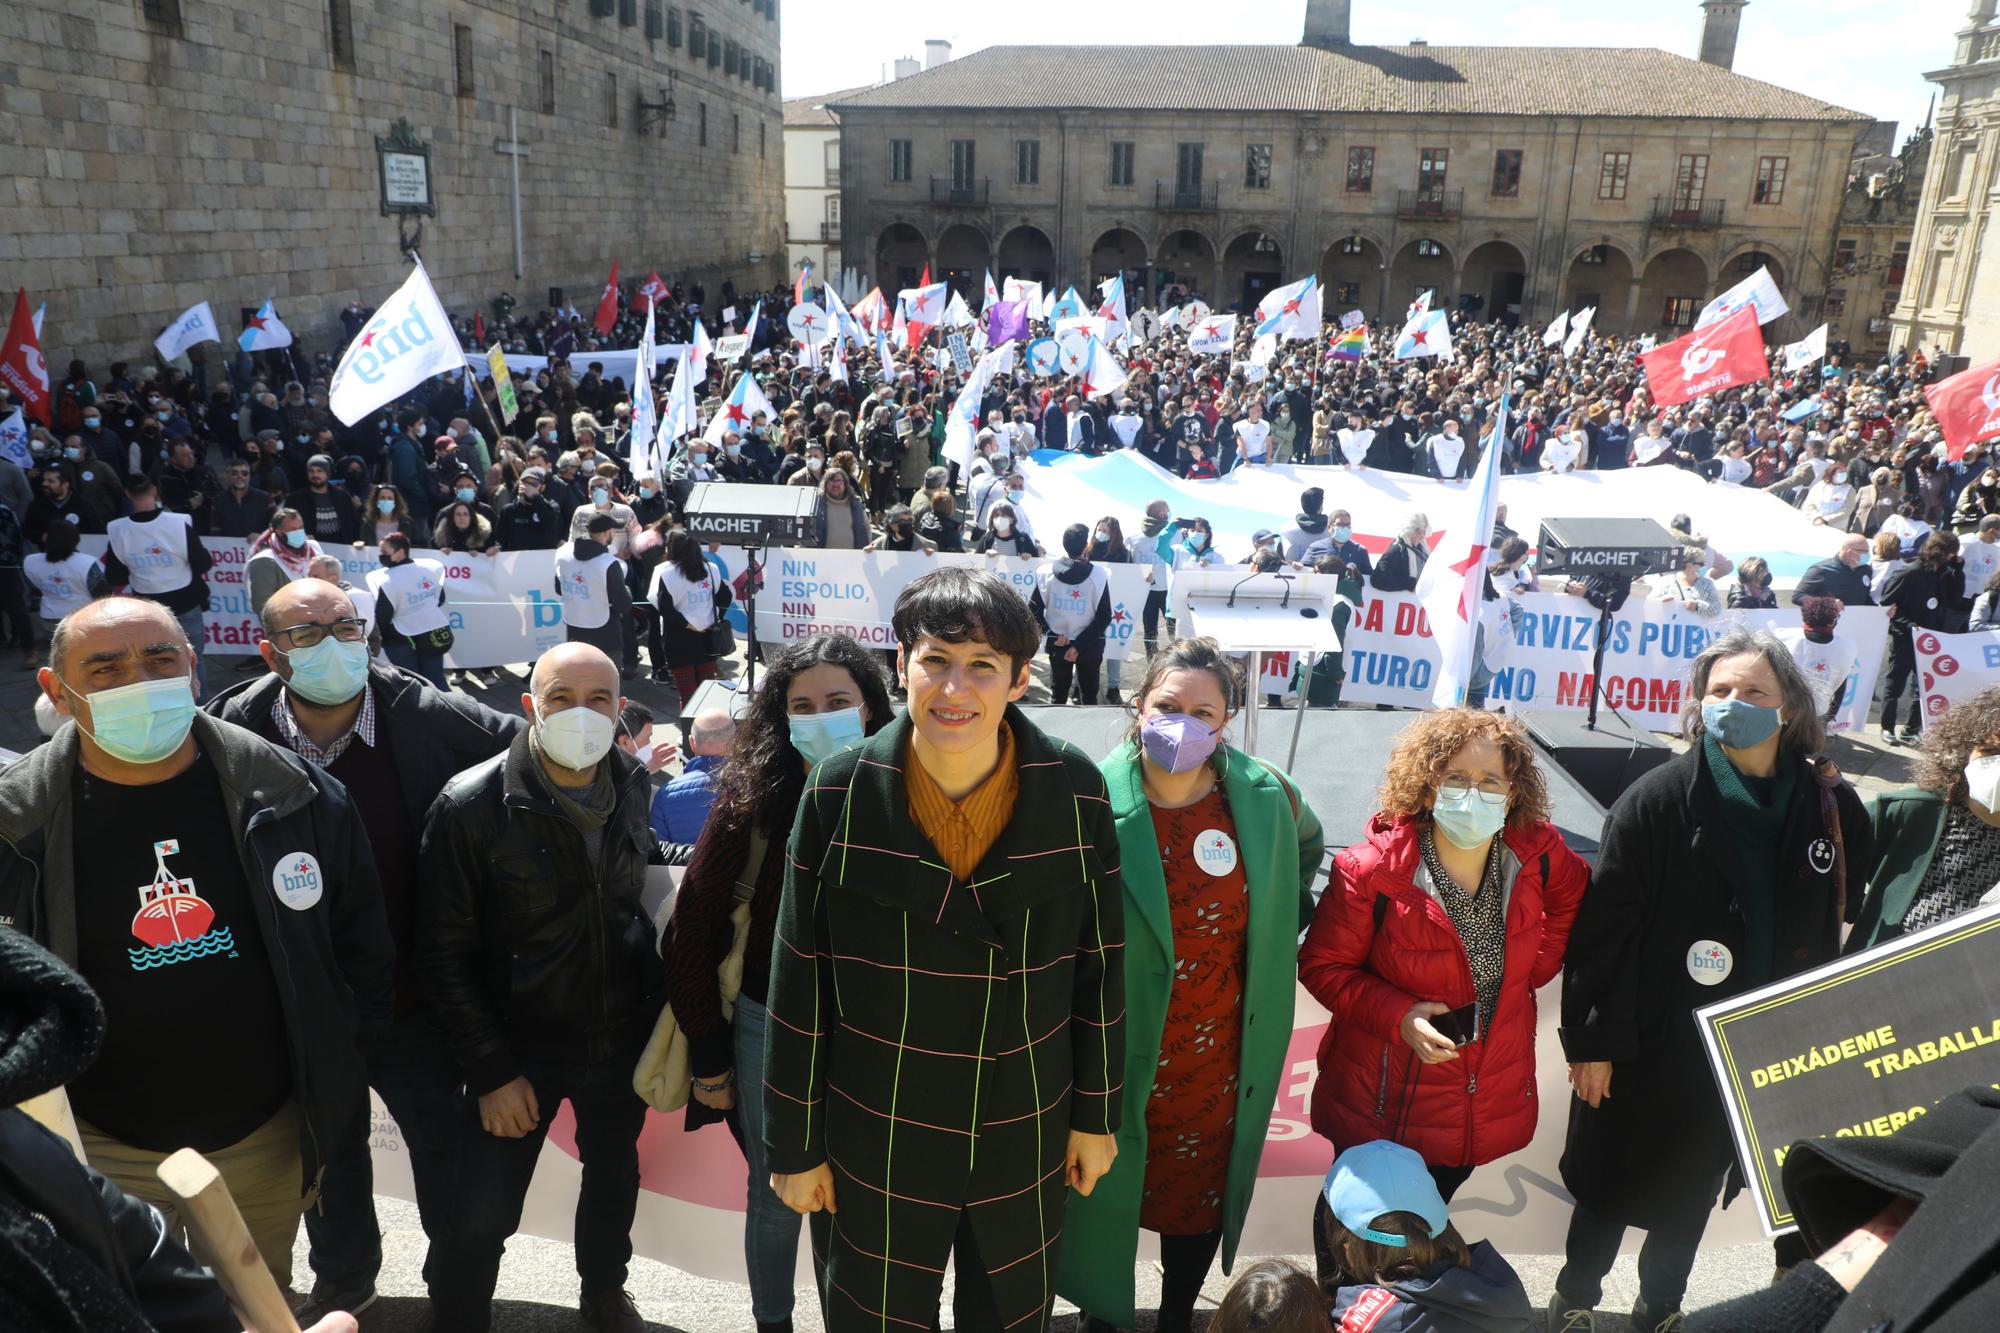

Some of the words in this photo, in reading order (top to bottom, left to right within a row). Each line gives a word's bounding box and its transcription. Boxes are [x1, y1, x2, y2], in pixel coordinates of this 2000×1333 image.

[690, 516, 763, 534] KACHET
[132, 552, 174, 570] bng
[782, 560, 816, 577] NIN
[1570, 550, 1640, 566] KACHET
[562, 574, 589, 600] bng
[782, 582, 870, 603] ESPOLIO,
[782, 602, 816, 620] NIN
[1052, 591, 1088, 615] bng
[1200, 845, 1232, 864] bng
[280, 871, 318, 892] bng
[1693, 951, 1726, 972] bng
[1750, 1025, 1897, 1088] DEIXÁDEME
[1350, 1296, 1380, 1327] DENIM
